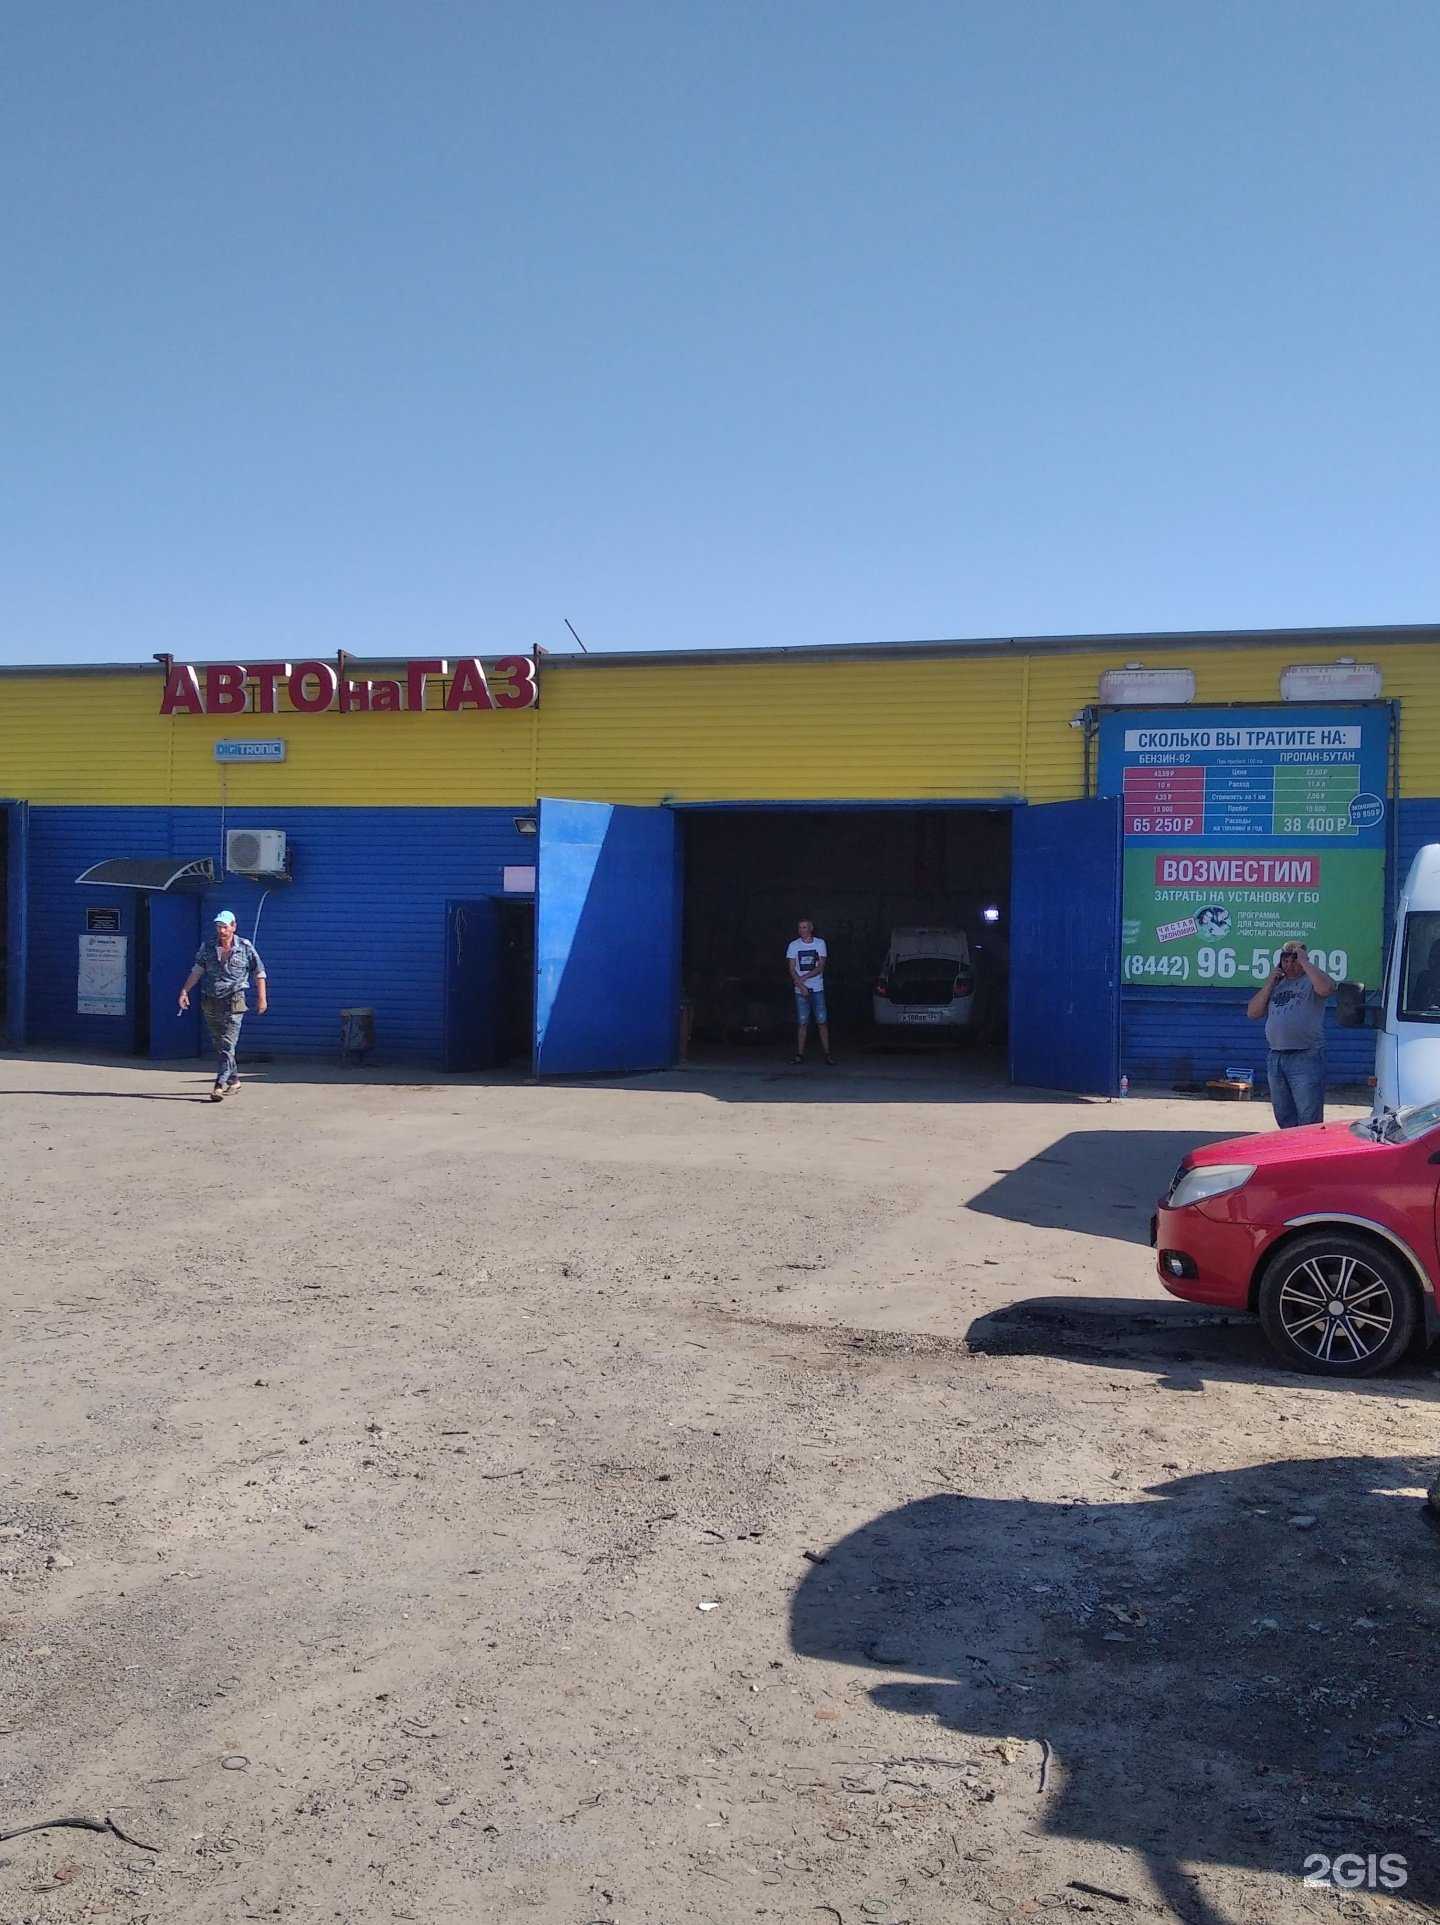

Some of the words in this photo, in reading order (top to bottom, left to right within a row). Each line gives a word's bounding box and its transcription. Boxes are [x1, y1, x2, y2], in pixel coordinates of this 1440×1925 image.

[1138, 733, 1211, 748] СКОЛЬКО
[1215, 732, 1241, 747] ВЫ
[1245, 731, 1316, 746] ТРАТИТЕ
[1320, 730, 1347, 745] НА:
[1138, 753, 1191, 764] БЕНЗИН-92
[1279, 751, 1355, 762] ПРОПАН-БУТАН
[1133, 818, 1152, 832] 65
[1283, 818, 1302, 831] 38
[1162, 860, 1312, 883] ВОЗМЕСТИМ
[1154, 890, 1207, 902] ЗАТРАТЫ
[1209, 891, 1225, 902] НА
[1228, 891, 1295, 903] УСТАНОВКУ
[1297, 891, 1320, 903] ГБО
[1237, 911, 1281, 919] ПРОГРАММА
[1158, 920, 1193, 933] ЧИСТАЯ
[1124, 955, 1190, 980] (8442)
